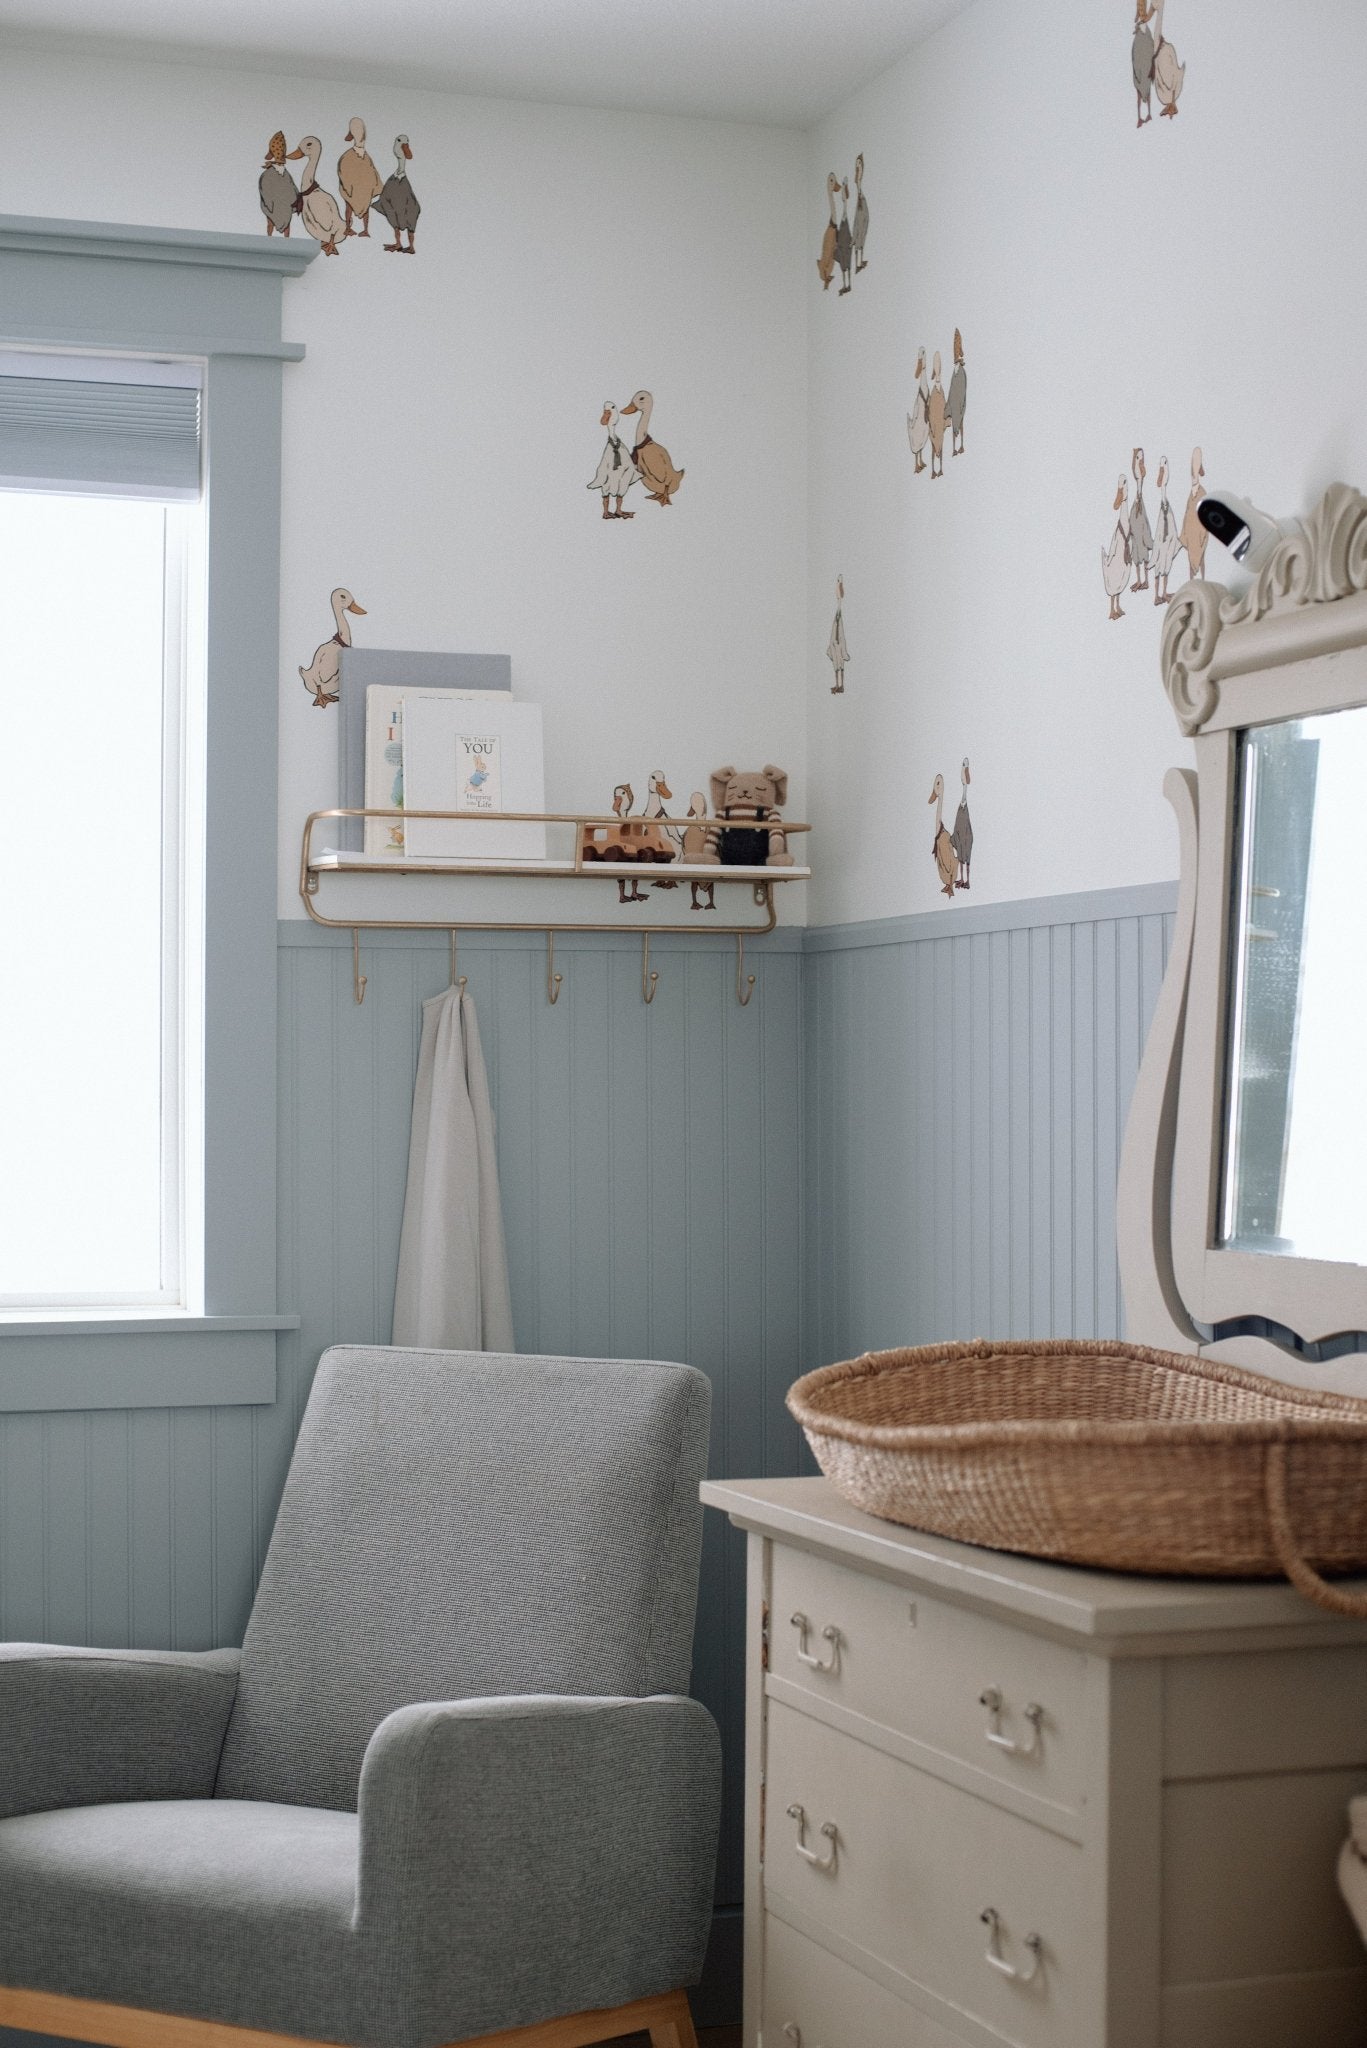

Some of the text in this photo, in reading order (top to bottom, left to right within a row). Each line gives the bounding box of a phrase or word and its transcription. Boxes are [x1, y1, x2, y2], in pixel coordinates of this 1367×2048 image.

[463, 743, 493, 754] YOU
[466, 793, 492, 802] Hopping
[477, 800, 492, 808] Life
